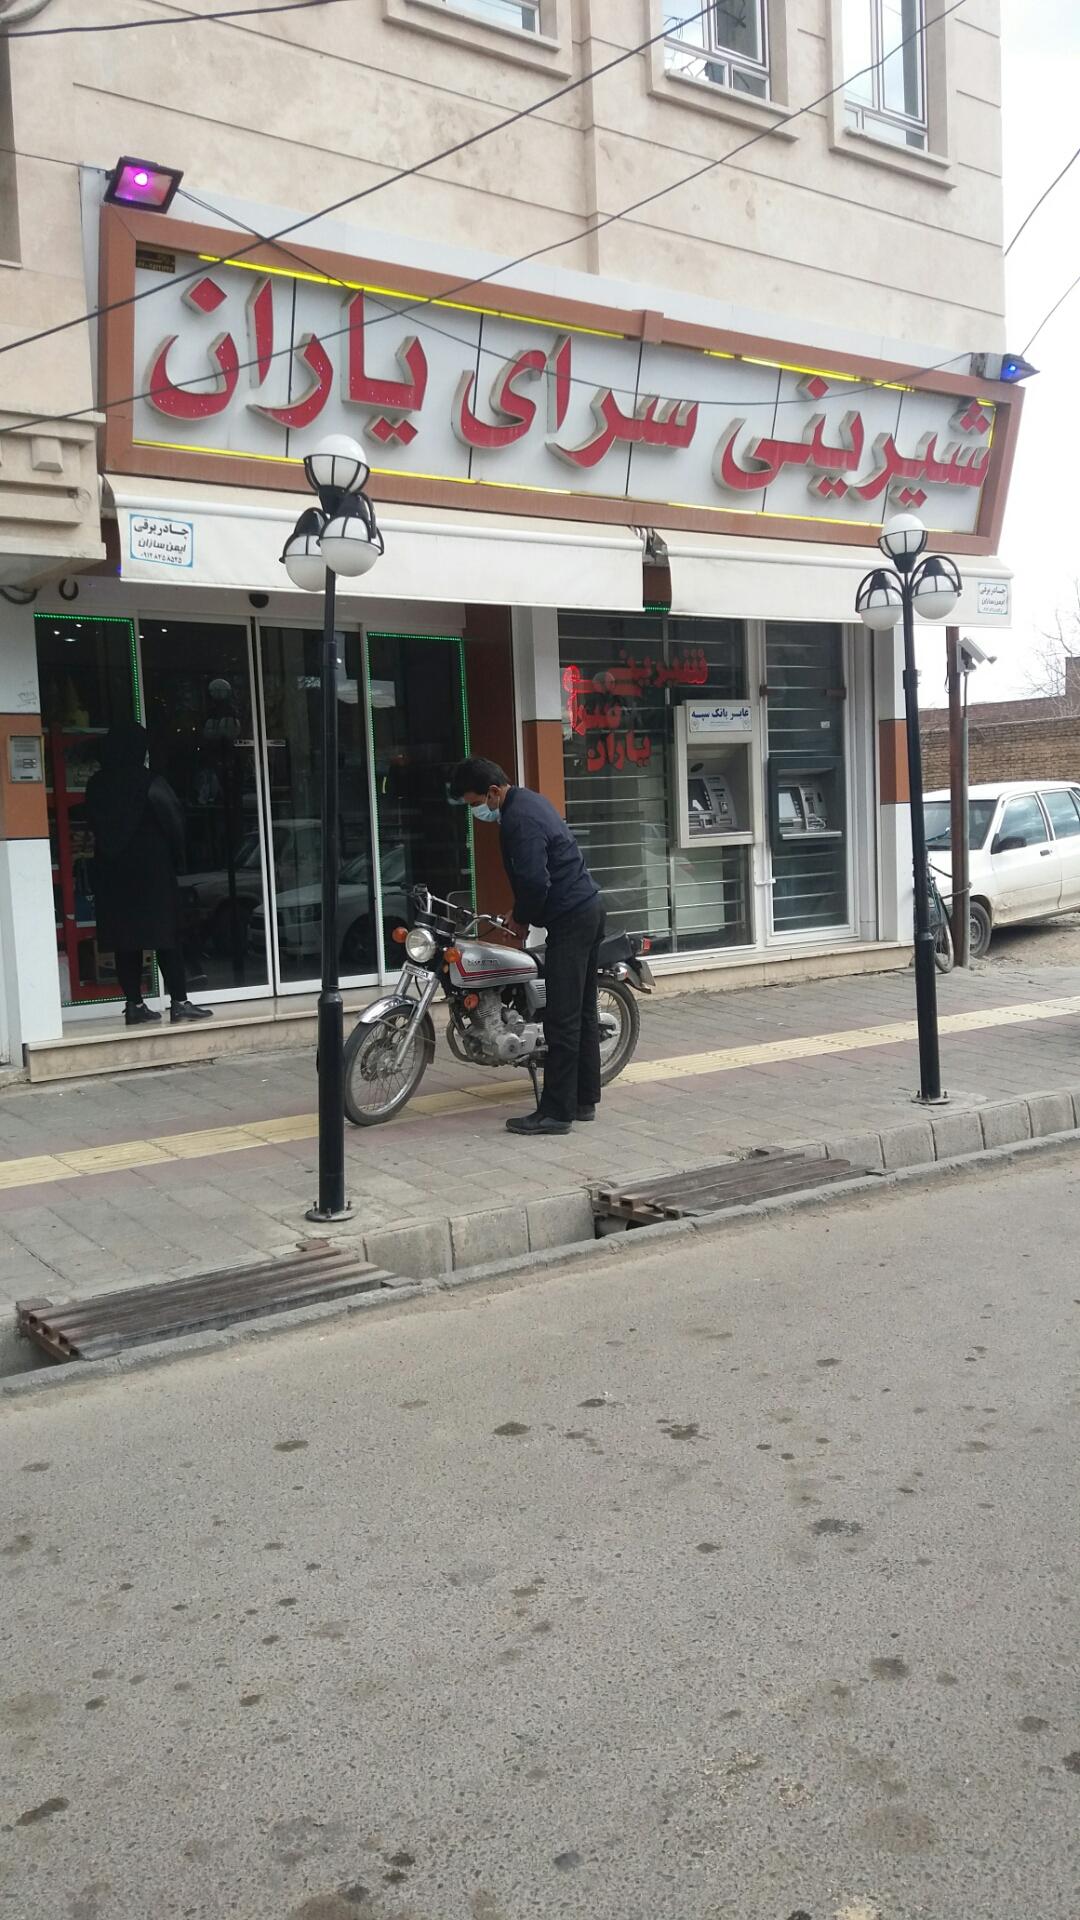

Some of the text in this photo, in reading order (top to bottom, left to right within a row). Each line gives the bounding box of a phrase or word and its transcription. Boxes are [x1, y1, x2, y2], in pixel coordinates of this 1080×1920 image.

[145, 275, 992, 509] شیرینی سرای یاران
[691, 707, 749, 722] عابر بانک سپه
[586, 730, 652, 772] یاران
